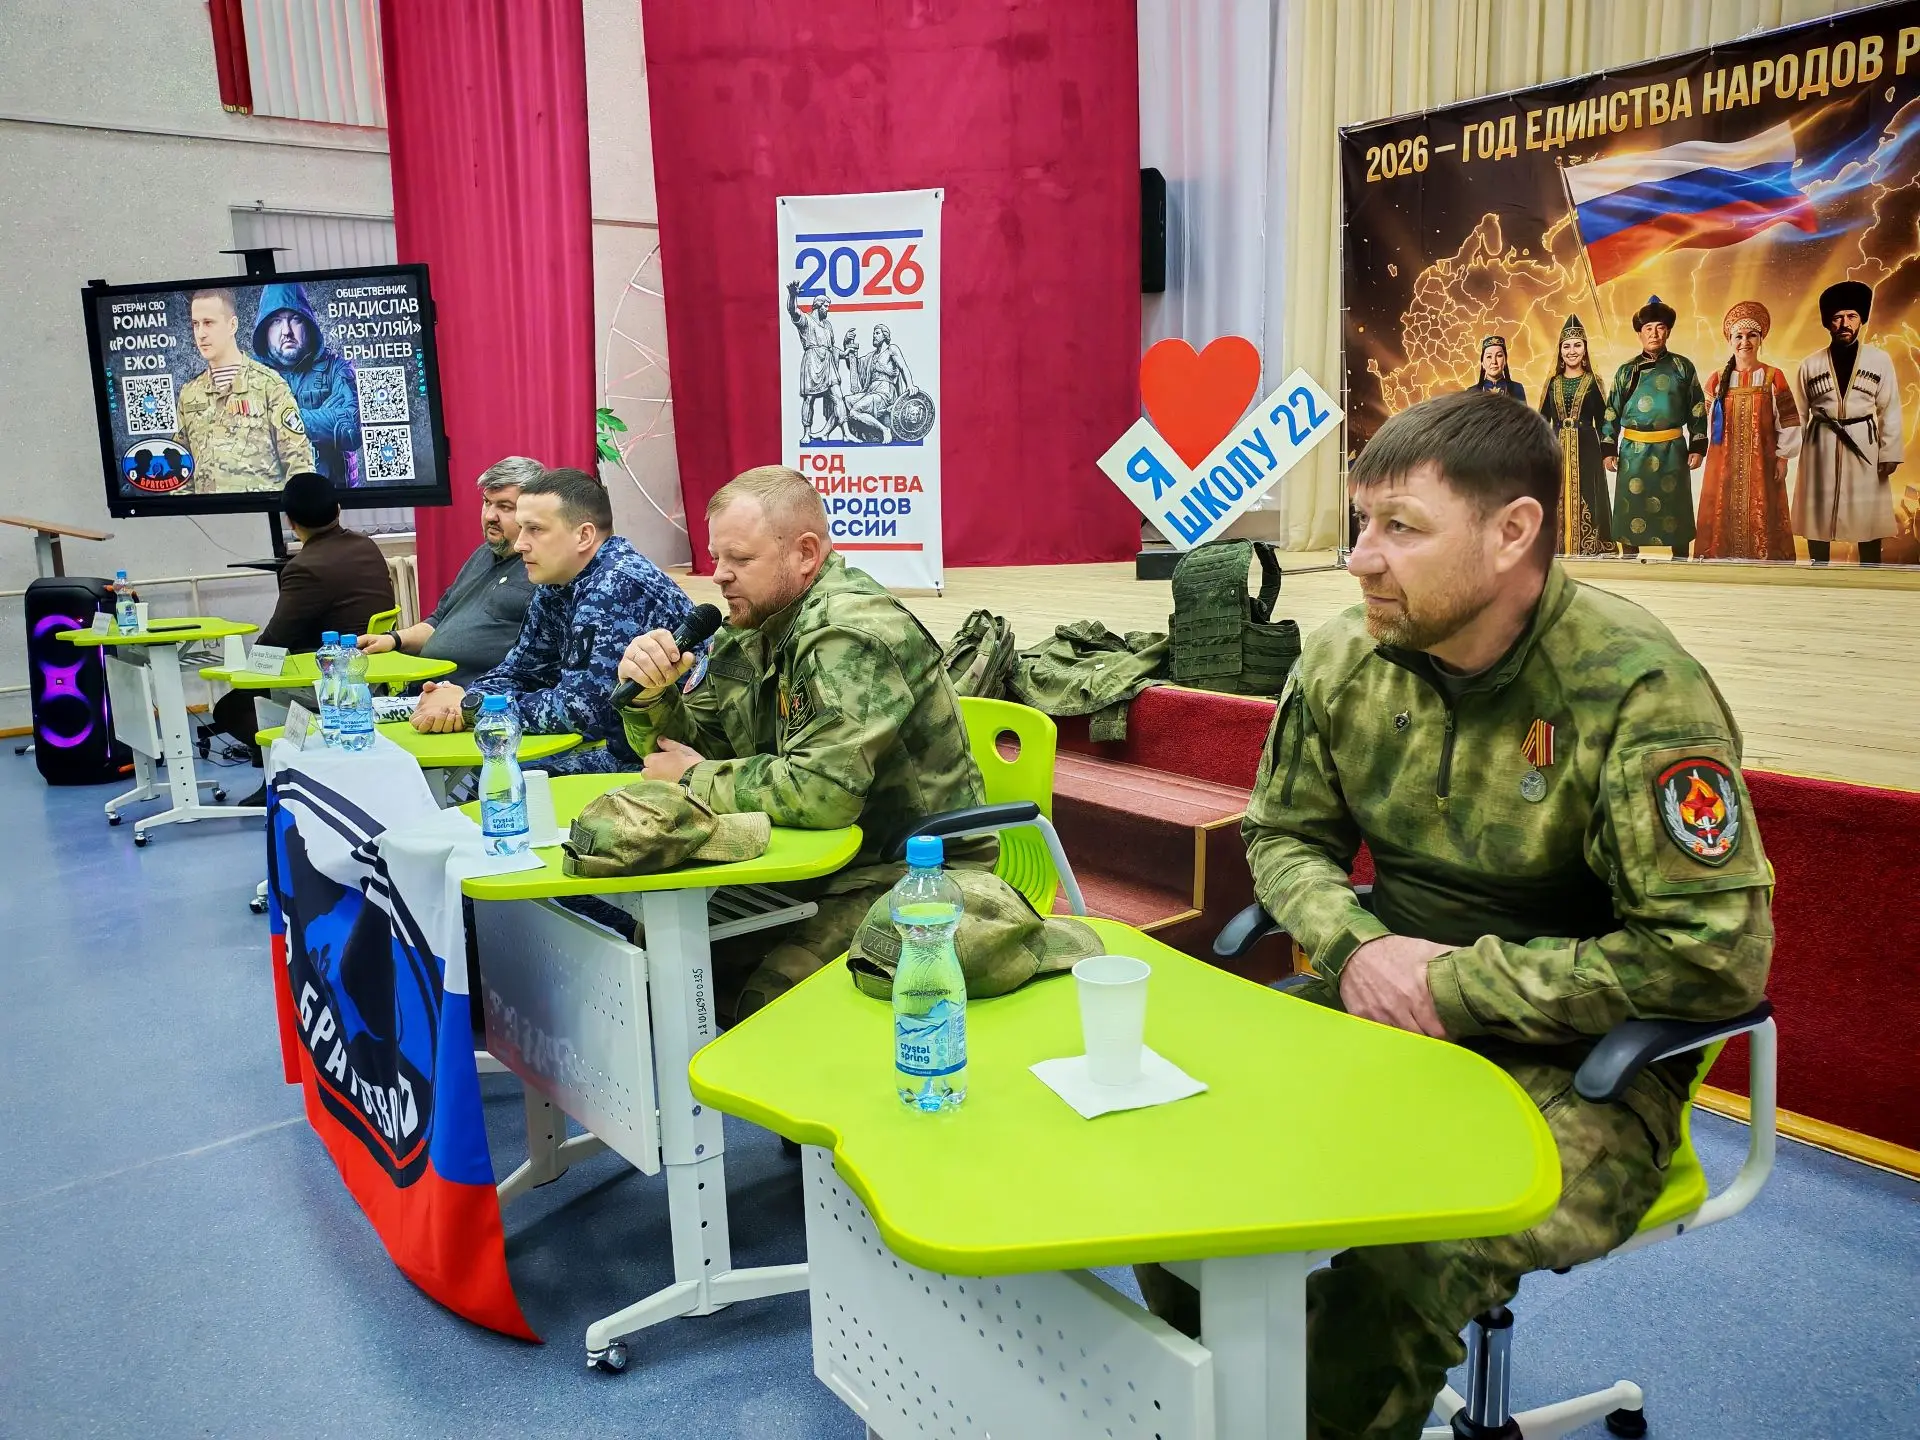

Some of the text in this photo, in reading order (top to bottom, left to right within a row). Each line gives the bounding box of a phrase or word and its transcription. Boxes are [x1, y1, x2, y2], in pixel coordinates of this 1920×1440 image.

[1365, 135, 1429, 183] 2026
[1462, 115, 1518, 163] ГОД
[1525, 77, 1693, 152] ЕДИНСТВА
[1702, 35, 1884, 115] НАРОДОВ
[795, 244, 924, 298] 2026
[336, 284, 408, 298] ОБЩЕСТВЕННИК
[112, 300, 166, 314] ВЕТЕРАН СВО
[327, 297, 419, 320] ВЛАДИСЛАВ
[113, 312, 168, 330] РОМАН
[329, 315, 422, 340] «РАЗГУЛЯЙ»
[109, 333, 177, 351] «РОМЕО»
[343, 342, 413, 360] БРЫЛЕЕВ
[124, 354, 166, 370] ЕЖОВ
[799, 454, 846, 474] ГОД
[1163, 386, 1330, 545] ШКОЛУ 22
[140, 476, 179, 489] БРАТСТВО
[1126, 446, 1177, 501] Я
[807, 475, 924, 496] ДИНСТВА
[827, 519, 897, 537] ССИИ
[900, 1042, 931, 1056] crystal
[900, 1051, 930, 1065] spring
